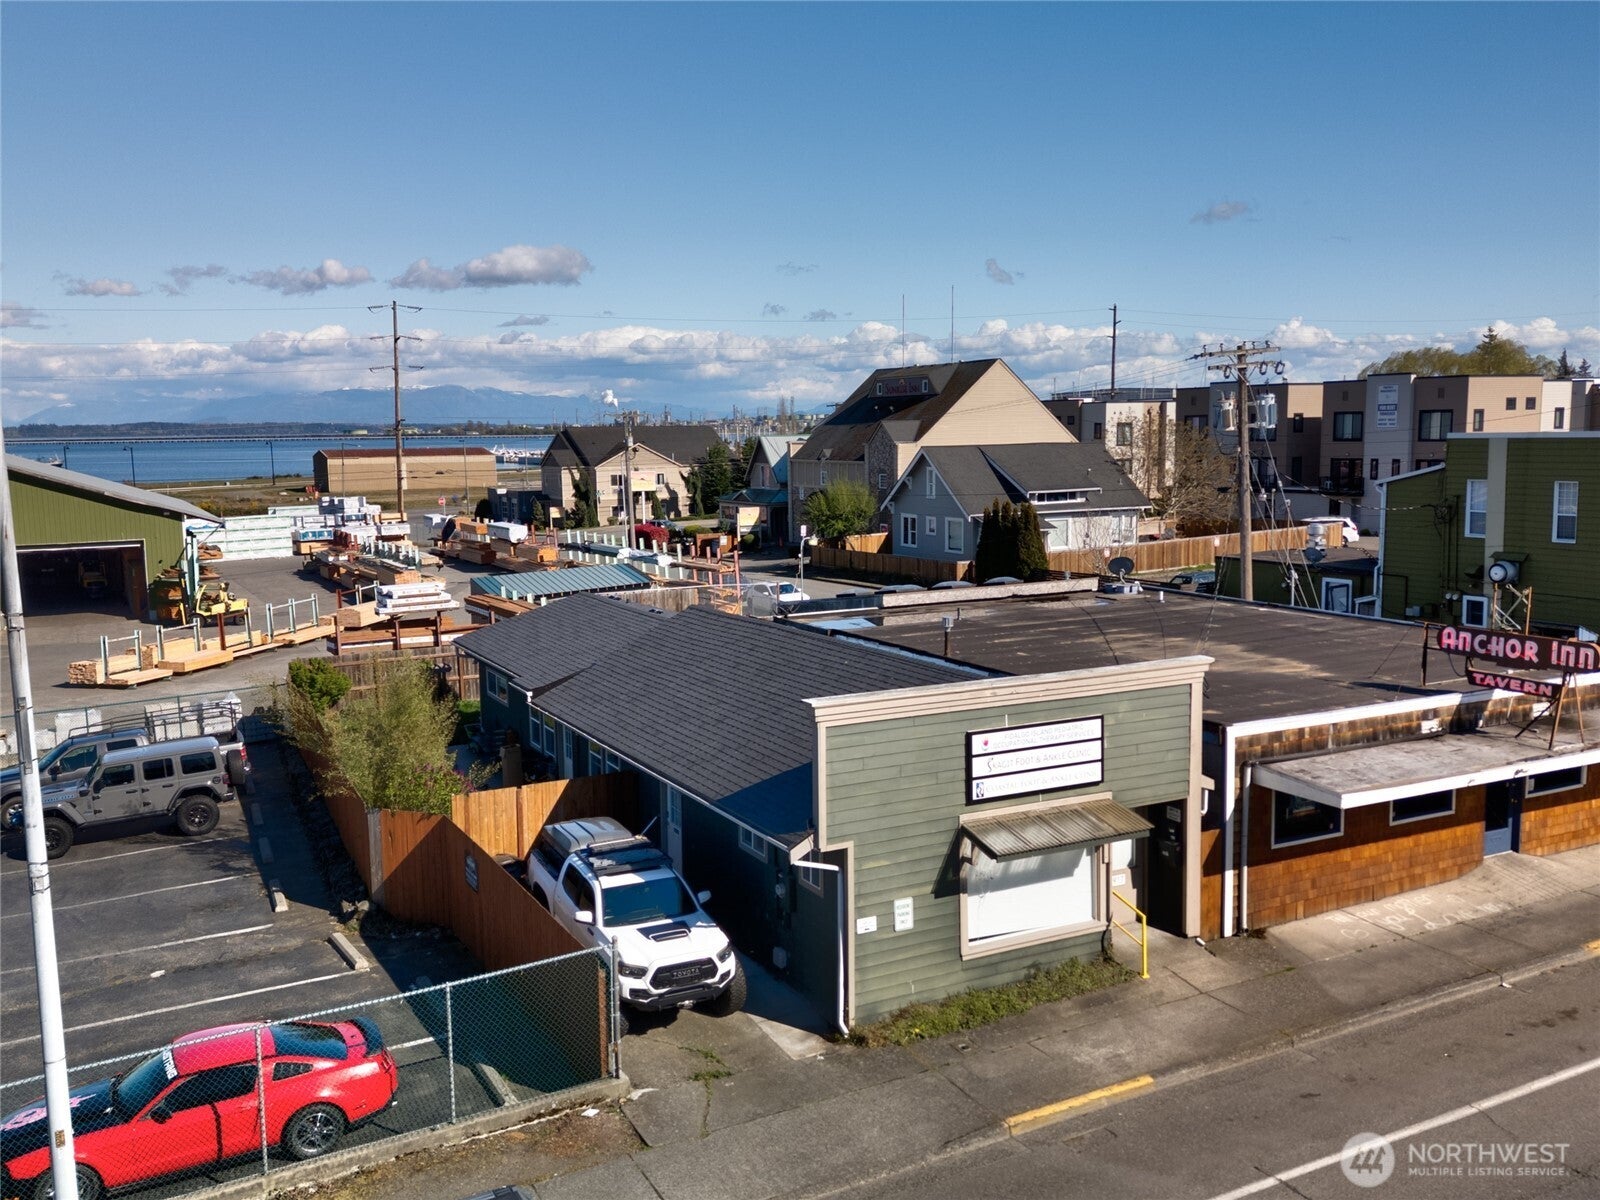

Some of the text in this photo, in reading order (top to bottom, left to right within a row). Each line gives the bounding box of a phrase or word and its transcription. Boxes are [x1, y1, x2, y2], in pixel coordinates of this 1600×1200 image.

[1441, 626, 1595, 670] ANCHOR INN
[1472, 672, 1552, 697] TAVERN
[1015, 755, 1033, 766] FOOT
[1035, 755, 1041, 763] &
[1043, 751, 1065, 762] ANKLE
[1067, 747, 1090, 758] CLINIC
[672, 968, 700, 978] TOYOTA
